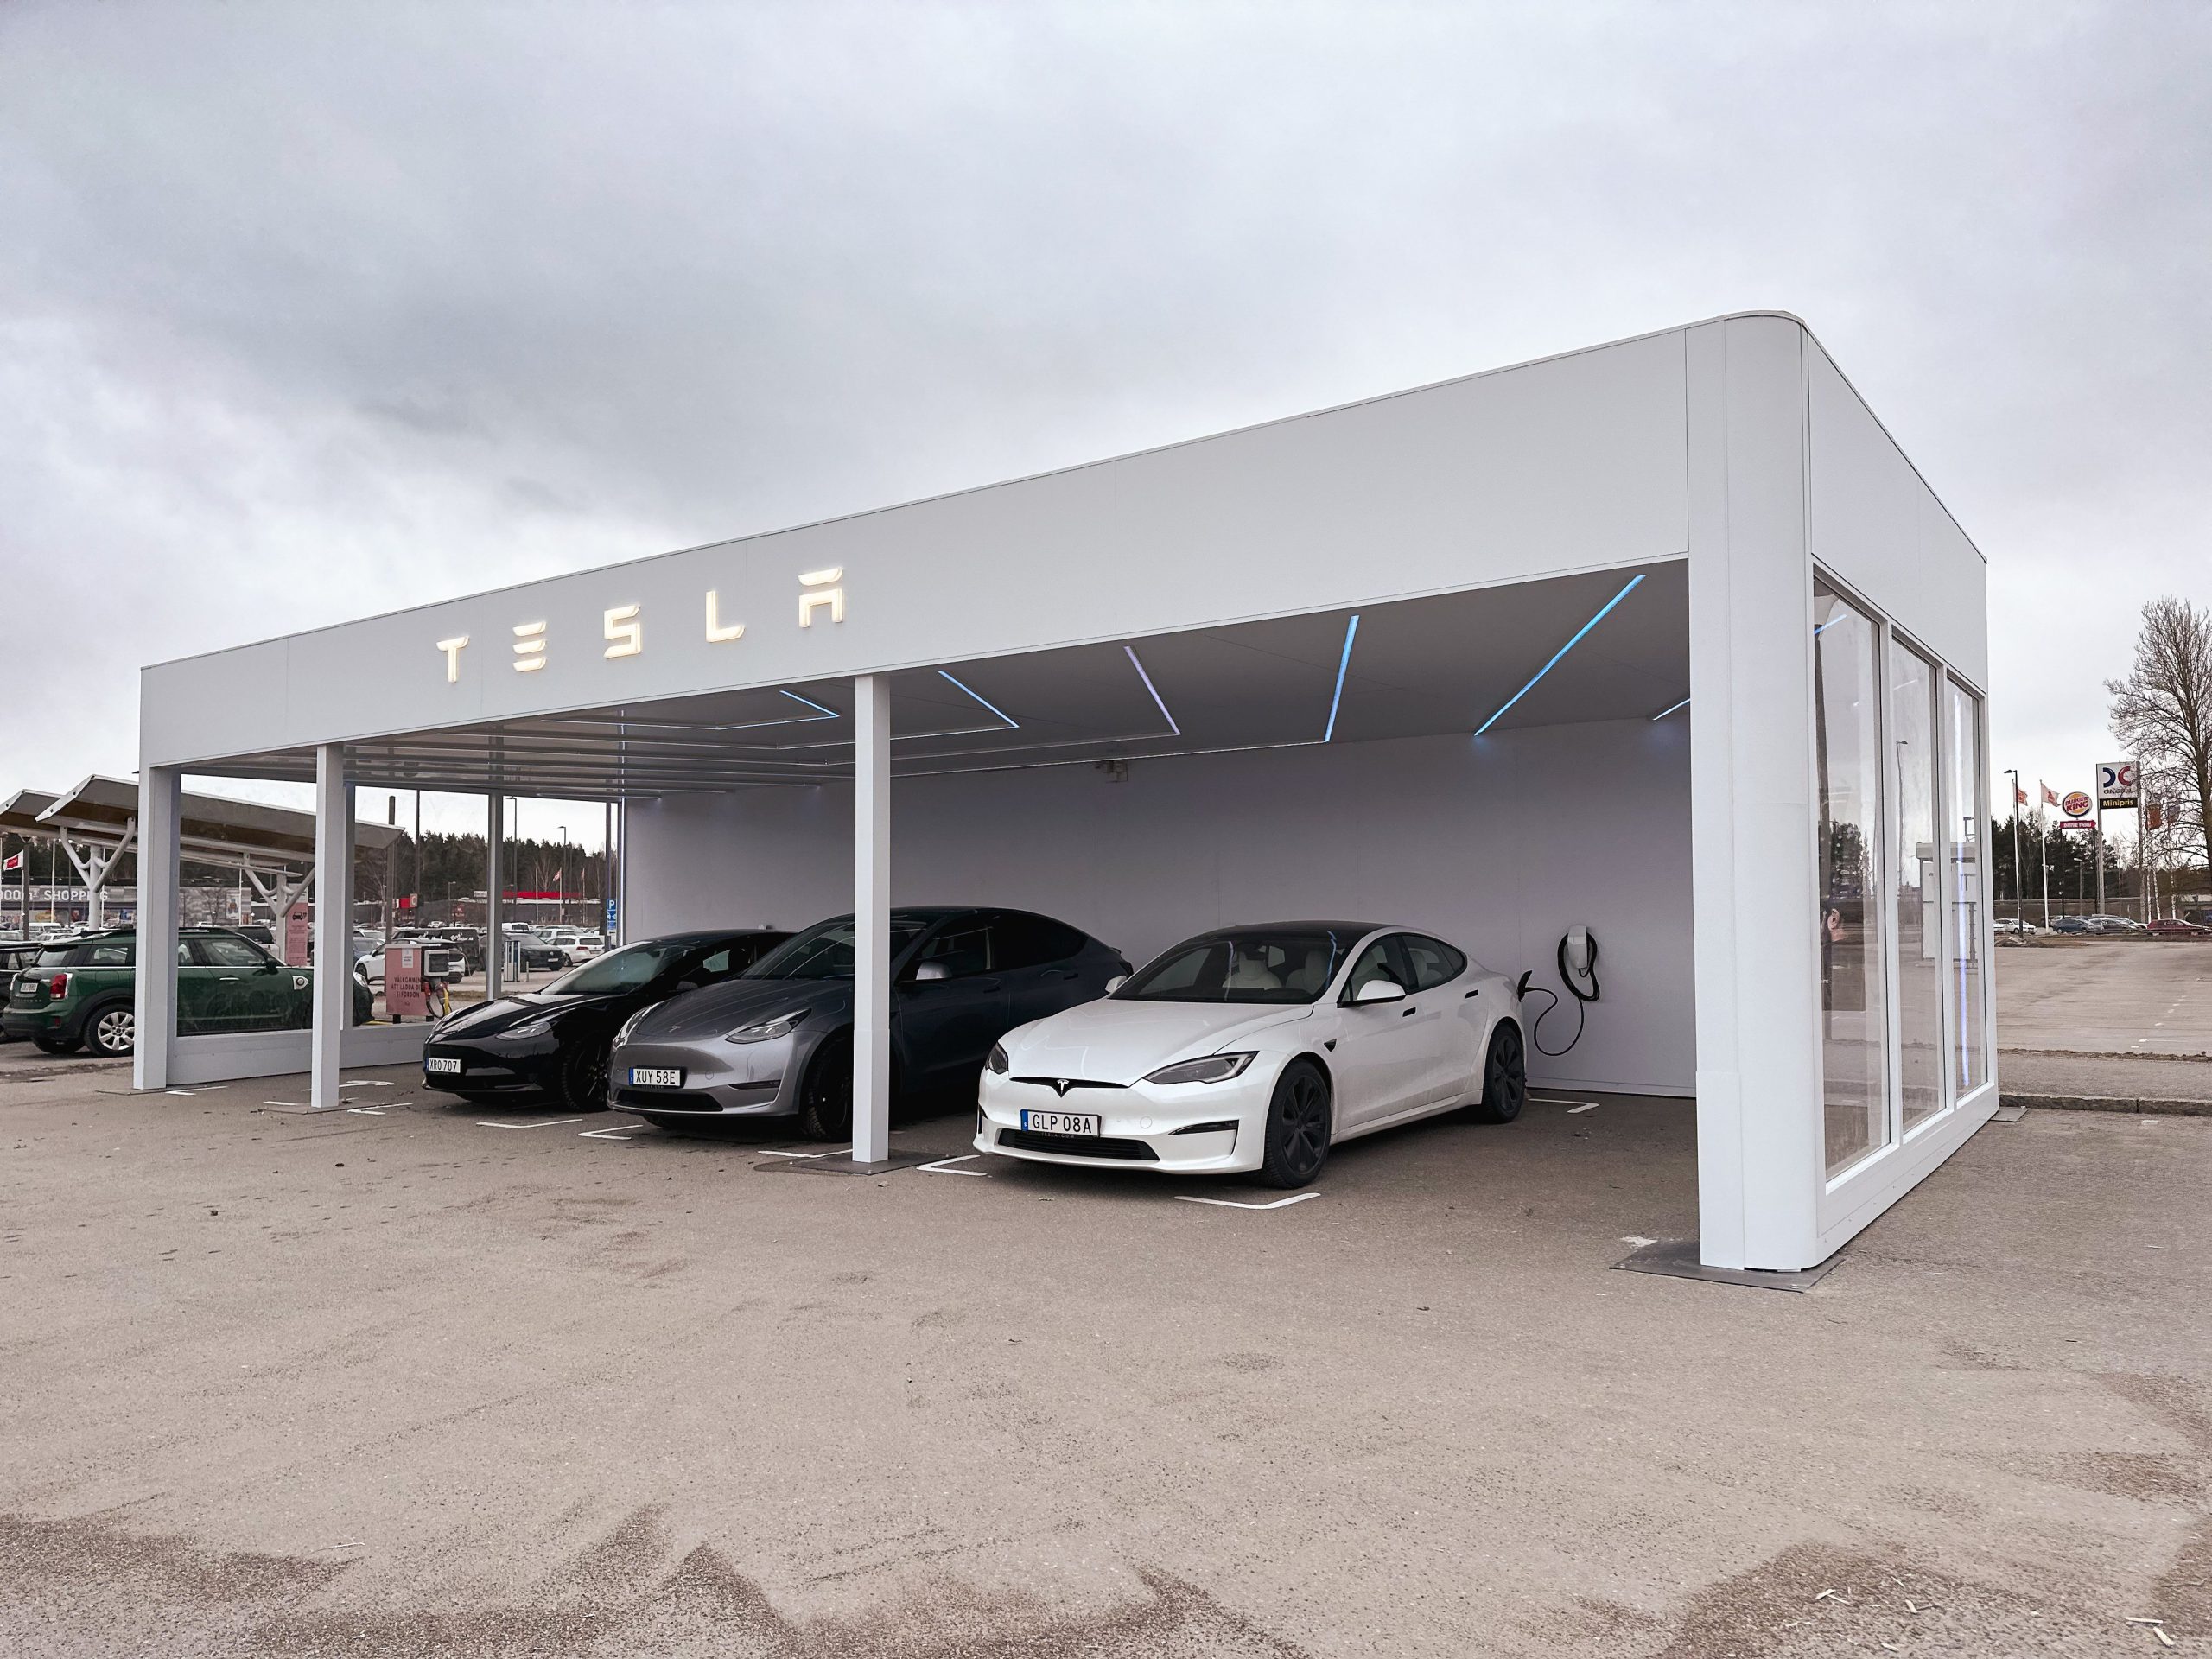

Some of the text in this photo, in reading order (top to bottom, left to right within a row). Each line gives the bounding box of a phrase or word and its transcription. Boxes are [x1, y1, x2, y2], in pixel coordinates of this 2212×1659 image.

[436, 567, 844, 683] TESLA
[2065, 796, 2088, 806] BURGER
[2066, 801, 2089, 811] KING
[2102, 798, 2134, 807] Minipris
[43, 889, 108, 901] SHOPPIG
[609, 899, 614, 909] P
[429, 1058, 457, 1071] XRO 707
[636, 1070, 676, 1084] XUY 58E
[1033, 1114, 1058, 1131] GLP
[1063, 1116, 1092, 1134] 08A
